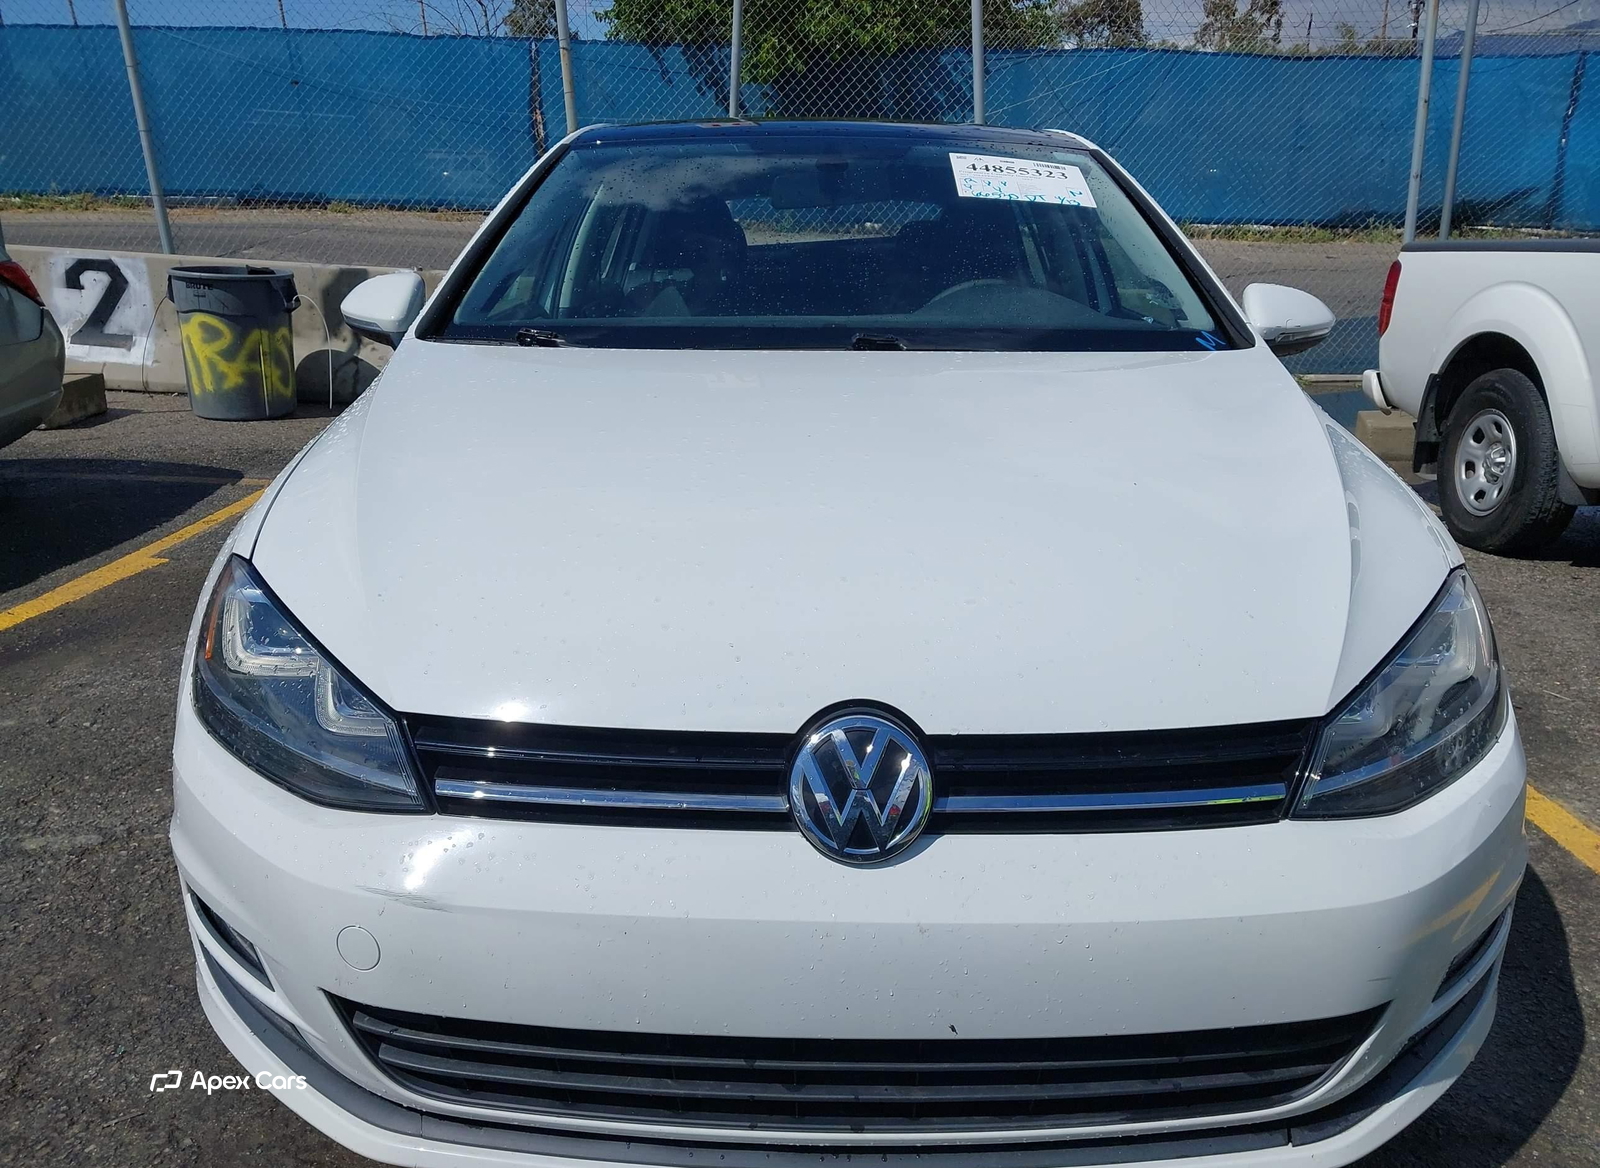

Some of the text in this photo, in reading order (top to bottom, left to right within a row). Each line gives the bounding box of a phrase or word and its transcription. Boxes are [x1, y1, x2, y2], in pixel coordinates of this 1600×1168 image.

[966, 163, 1068, 180] 44855323
[65, 258, 134, 351] 2
[798, 720, 926, 856] VW
